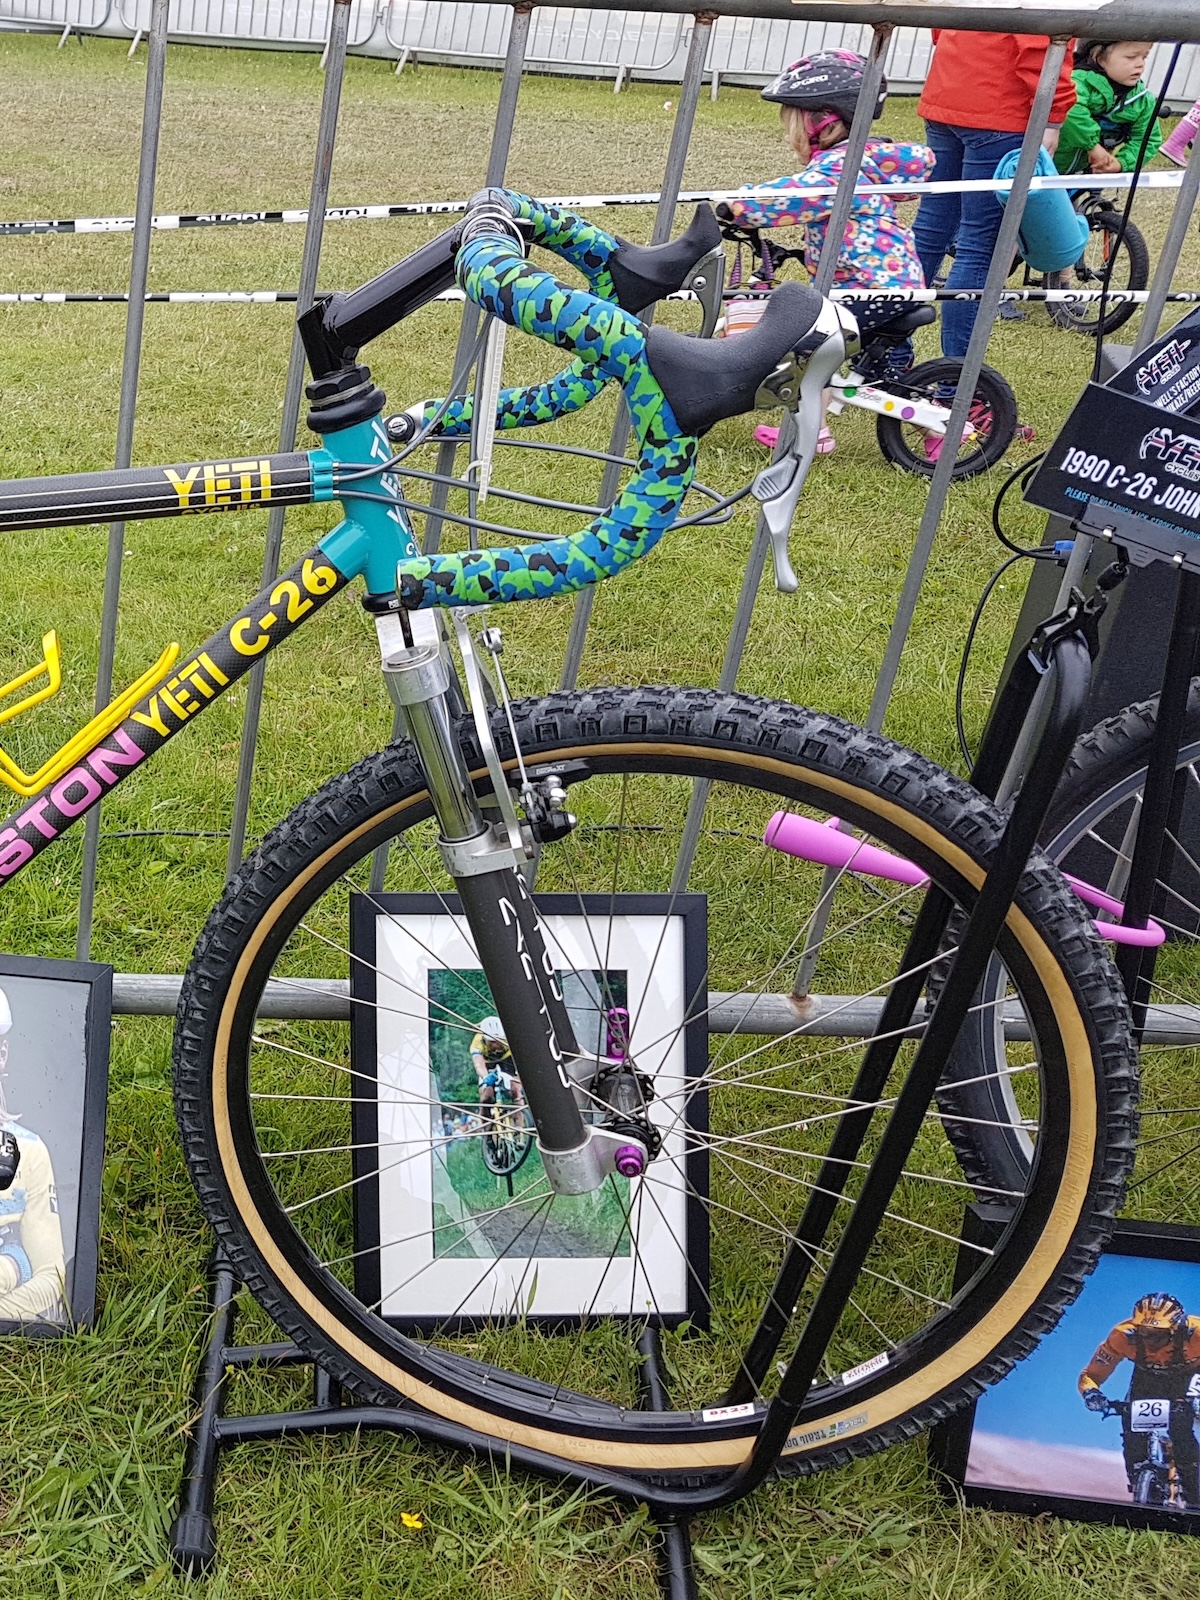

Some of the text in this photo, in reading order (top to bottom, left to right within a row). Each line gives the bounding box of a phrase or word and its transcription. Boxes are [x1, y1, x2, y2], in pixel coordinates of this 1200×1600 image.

[1142, 339, 1187, 386] YETI
[1158, 427, 1200, 471] YE
[163, 459, 272, 508] YETI
[1060, 447, 1111, 483] 1990
[1106, 465, 1158, 500] C-26
[1165, 463, 1200, 482] CYCLES
[1064, 486, 1091, 502] PLEASE
[130, 652, 230, 738] YETI
[229, 558, 338, 657] C-26
[1138, 1401, 1163, 1418] 26
[784, 1436, 799, 1449] DA
[800, 1428, 827, 1445] TRAIL
